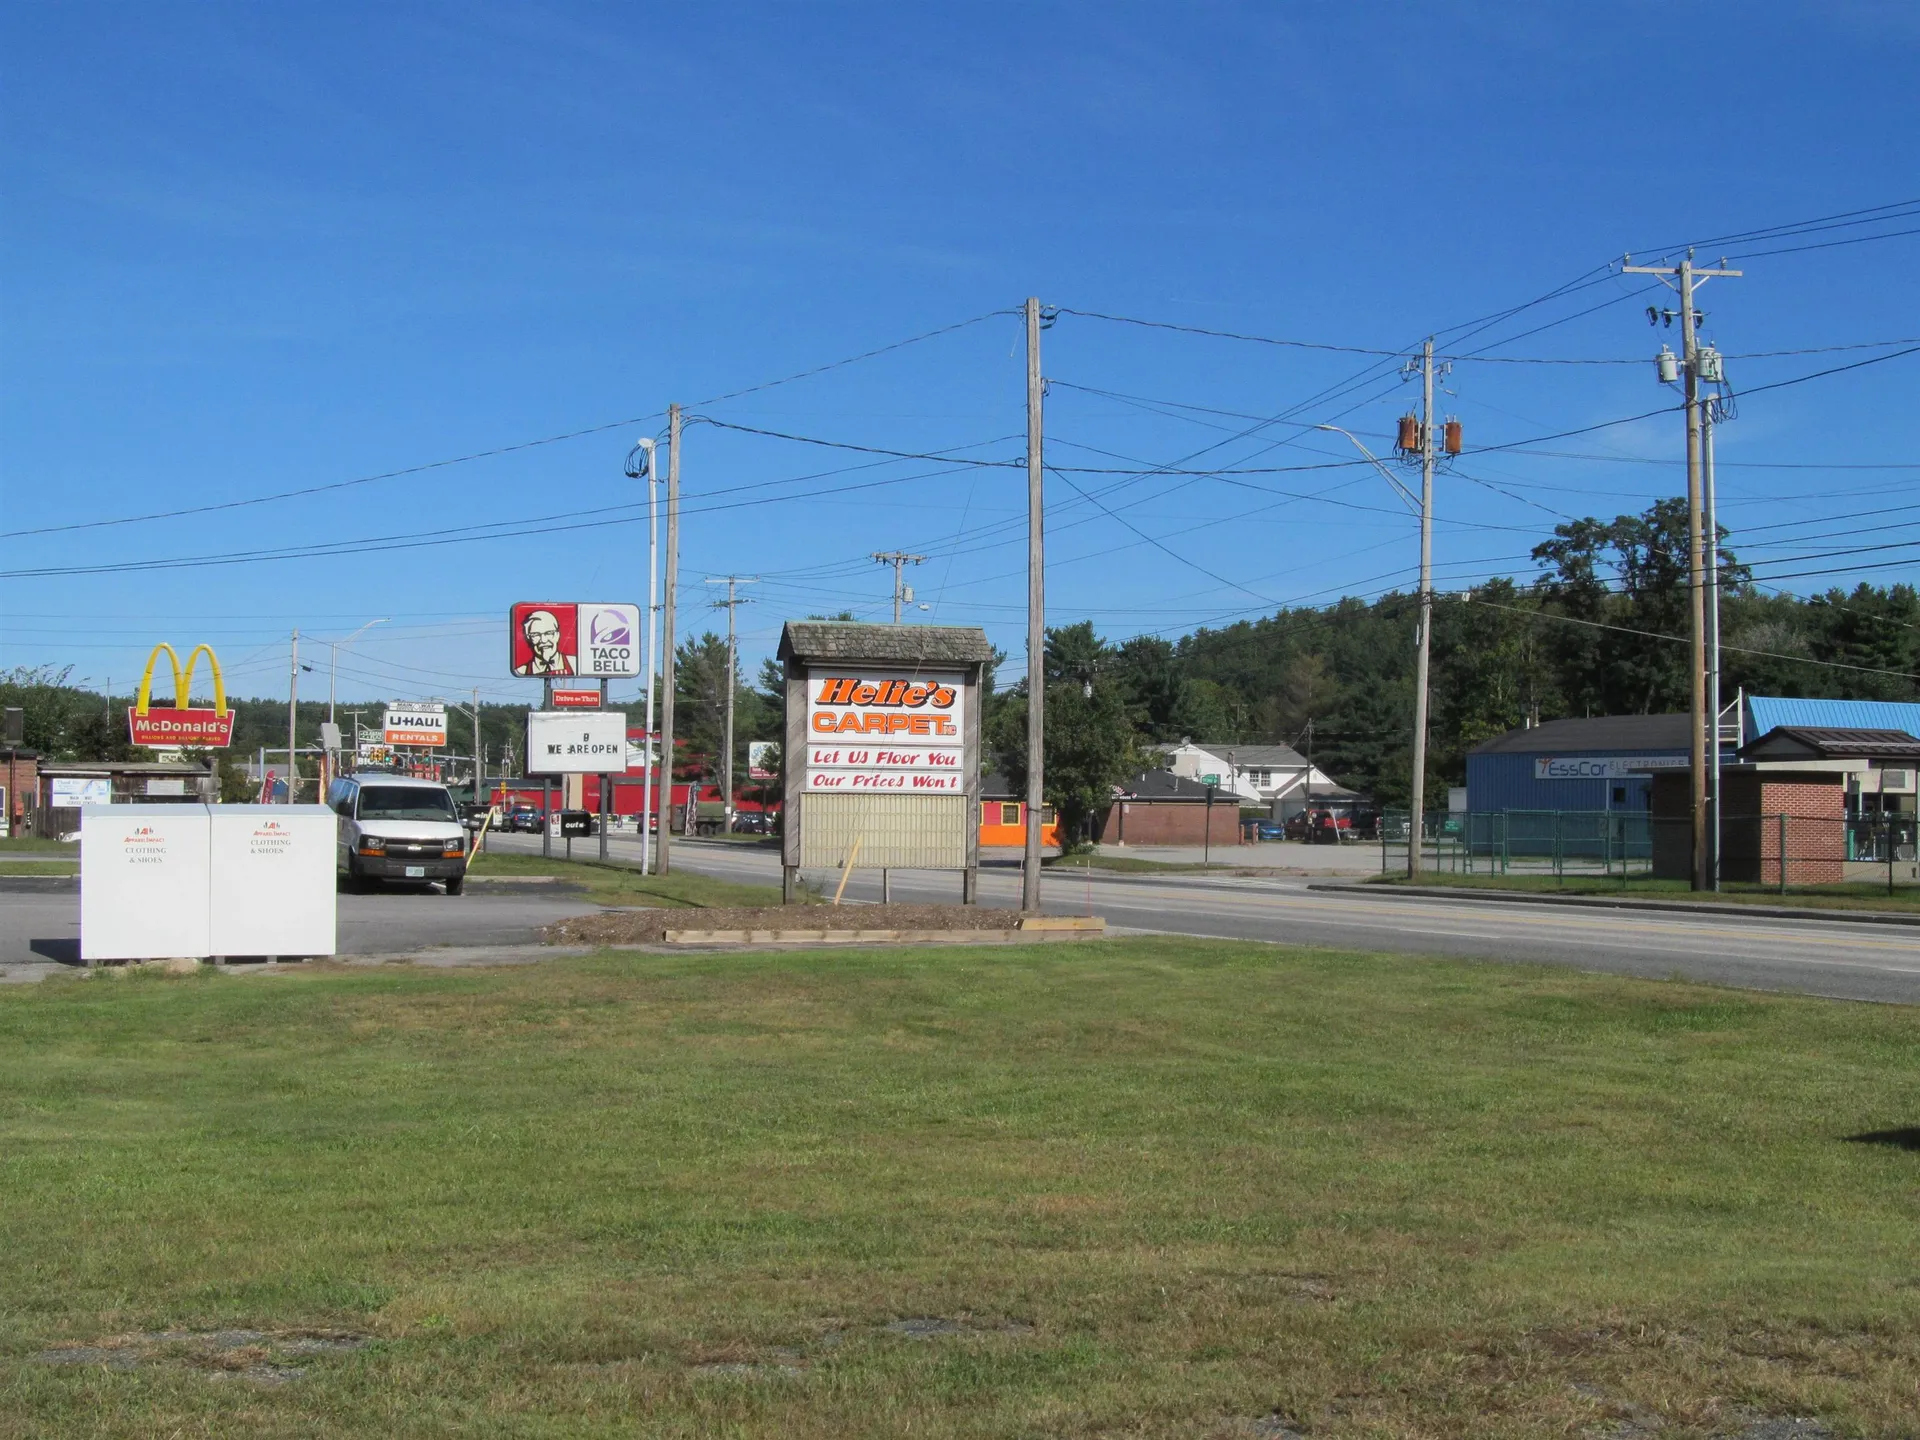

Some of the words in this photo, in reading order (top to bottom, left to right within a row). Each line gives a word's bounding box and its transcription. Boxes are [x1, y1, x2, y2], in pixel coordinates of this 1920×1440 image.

[590, 647, 631, 659] TACO
[593, 660, 630, 672] BELL
[815, 678, 957, 709] Helie's
[136, 720, 228, 733] McDonald's
[812, 711, 952, 735] CARPET
[392, 733, 438, 742] RENTALS
[547, 744, 562, 754] WE
[591, 744, 618, 753] OPEN
[813, 751, 840, 764] Let
[876, 751, 920, 765] Floor
[928, 752, 956, 765] You
[1549, 761, 1608, 776] EssCor
[813, 774, 846, 787] Our
[853, 774, 905, 788] Prices
[912, 775, 957, 788] Won't
